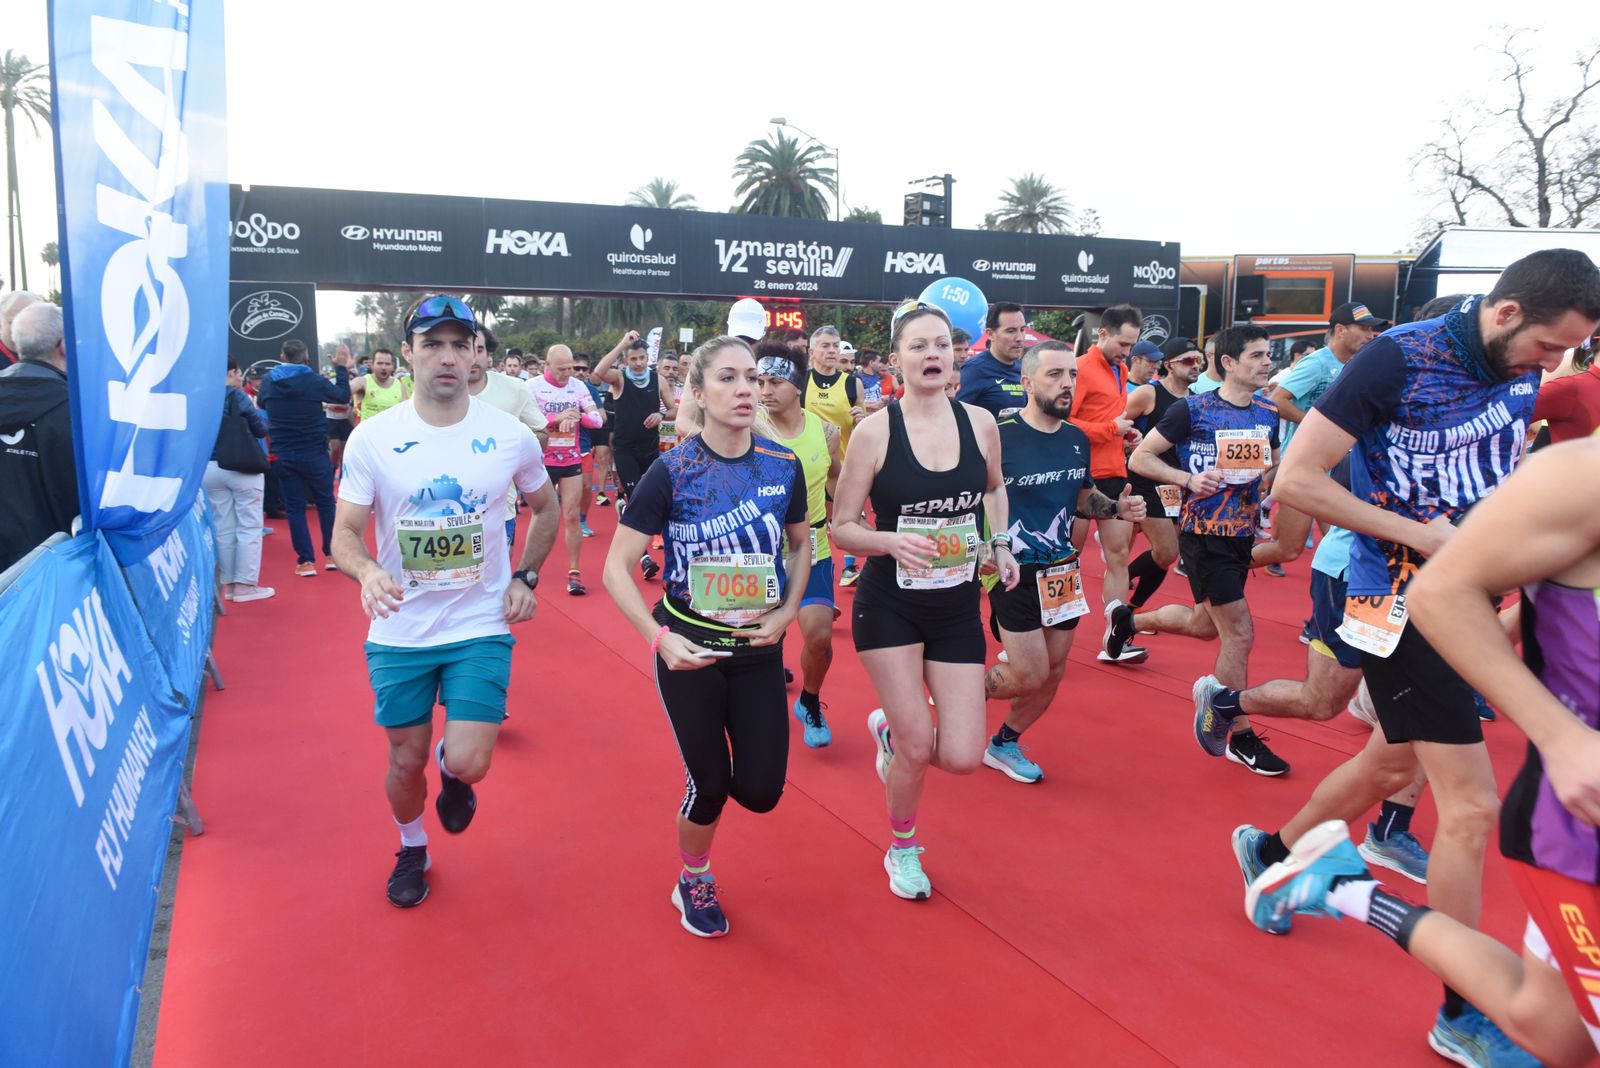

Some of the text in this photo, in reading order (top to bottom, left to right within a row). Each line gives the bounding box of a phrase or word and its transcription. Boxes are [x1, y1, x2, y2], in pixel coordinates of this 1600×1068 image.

[373, 228, 442, 242] HYUNDAI
[486, 229, 569, 257] HOKA
[373, 242, 442, 252] Hyundauto Motor
[742, 239, 833, 260] maratón
[613, 267, 671, 277] Healthcare Partner
[884, 251, 946, 274] HOKA
[992, 261, 1037, 273] HYUNDAI
[754, 280, 818, 291] 28 enero 2024
[941, 284, 970, 306] 1:50
[1386, 400, 1513, 454] MEDIO MARATÓN
[1189, 440, 1216, 456] MEDIO
[1226, 444, 1260, 460] 5233
[1017, 469, 1065, 487] SIEMPRE
[757, 484, 787, 497] HOKA
[901, 490, 983, 516] ESPAÑA
[447, 515, 472, 527] SEVILLA
[669, 498, 763, 541] MEDIO MARATÓN
[409, 534, 465, 558] 7492
[703, 573, 759, 597] 7068
[1047, 575, 1073, 598] 521
[35, 587, 133, 808] HOKA
[108, 730, 150, 842] HUMAN
[95, 808, 123, 891] FLY
